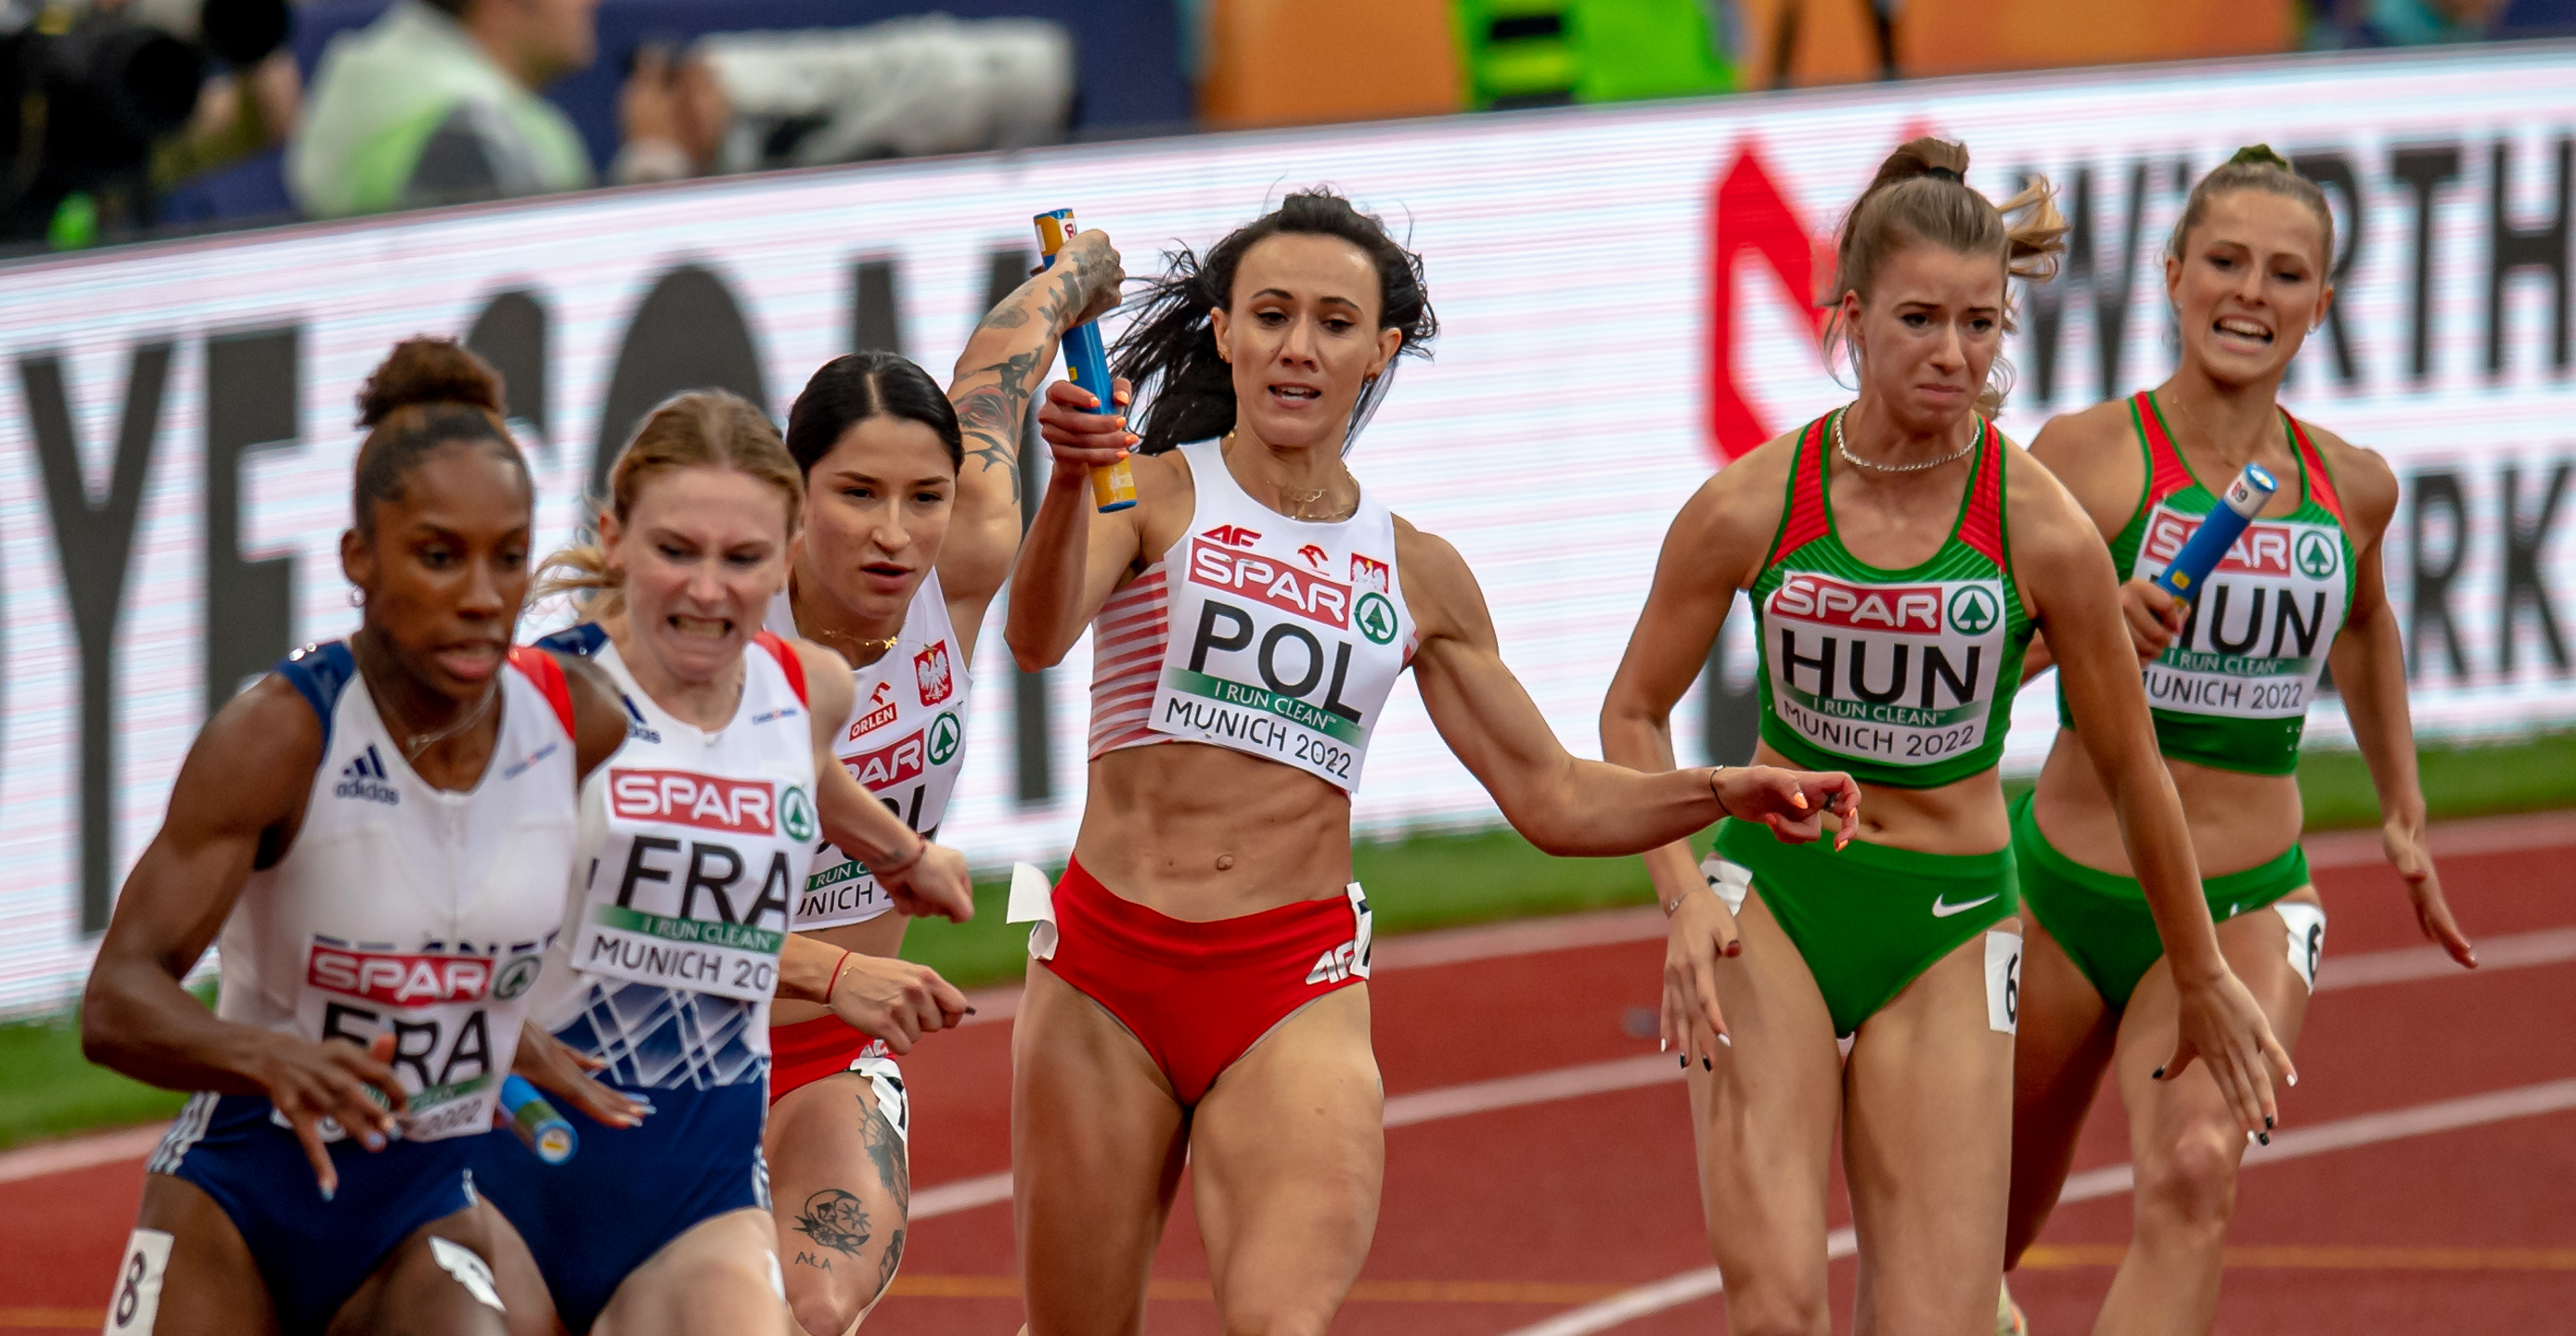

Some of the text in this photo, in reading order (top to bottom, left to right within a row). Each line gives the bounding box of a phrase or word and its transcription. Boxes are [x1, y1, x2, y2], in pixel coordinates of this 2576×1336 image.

[2012, 135, 2576, 405] WRTH
[2151, 520, 2286, 571] SAR
[1194, 546, 1346, 623] SPAR
[1776, 580, 1938, 629] SPAR
[1188, 598, 1363, 726] POL
[1781, 627, 1981, 709] HUN
[2168, 648, 2175, 665] I
[2180, 650, 2220, 671] RUN
[1214, 681, 1222, 697] I
[1227, 683, 1270, 709] RUN
[1813, 697, 1820, 712] I
[1824, 698, 1867, 719] RUN
[2250, 681, 2303, 710] 2022
[851, 707, 895, 737] ORLEN
[1166, 697, 1352, 779] MUNICH 2022
[1784, 699, 1975, 758] MUNICH 2022
[335, 780, 400, 805] adidas
[615, 775, 771, 829] SPAR
[616, 835, 792, 931] FRA
[797, 880, 873, 917] NICH
[816, 864, 852, 888] RUN
[658, 919, 700, 942] RUN
[315, 952, 487, 1003] SPAR
[589, 934, 723, 983] MUNICH
[732, 957, 774, 992] 20
[2005, 953, 2019, 1025] 6
[323, 1000, 491, 1088] FRA
[116, 1250, 148, 1329] 8
